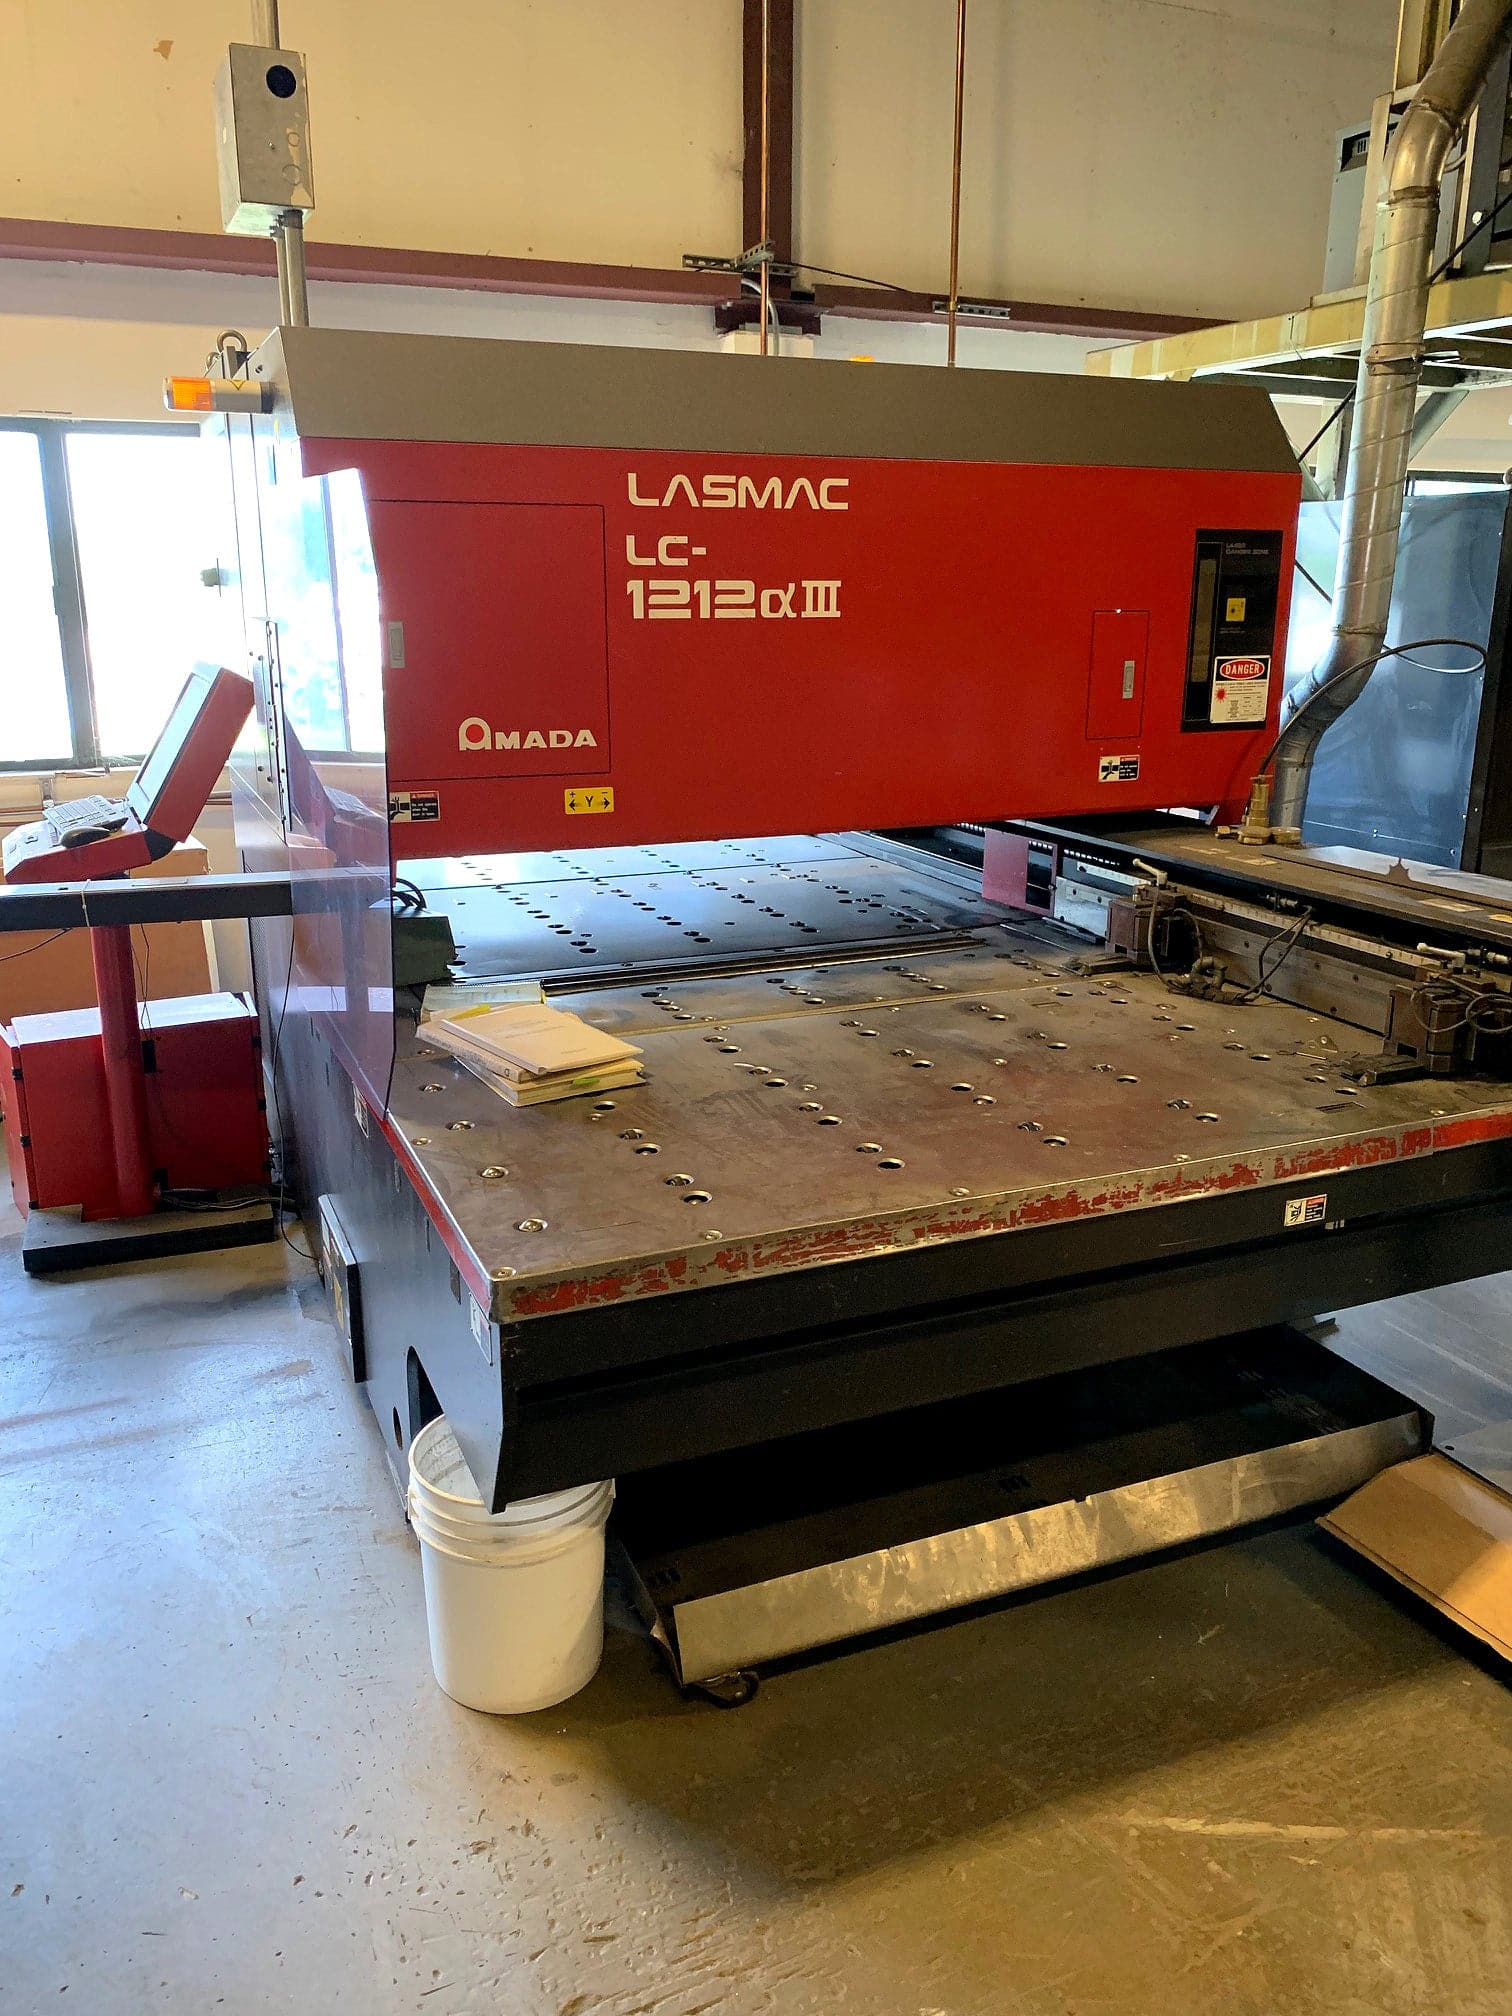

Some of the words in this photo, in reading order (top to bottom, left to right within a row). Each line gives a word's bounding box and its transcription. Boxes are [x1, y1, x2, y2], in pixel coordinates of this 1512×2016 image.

[627, 472, 849, 510] LASMAC
[626, 534, 707, 566] LC-
[1225, 663, 1261, 675] DANGER
[458, 716, 598, 751] AMADA
[585, 795, 594, 808] Y
